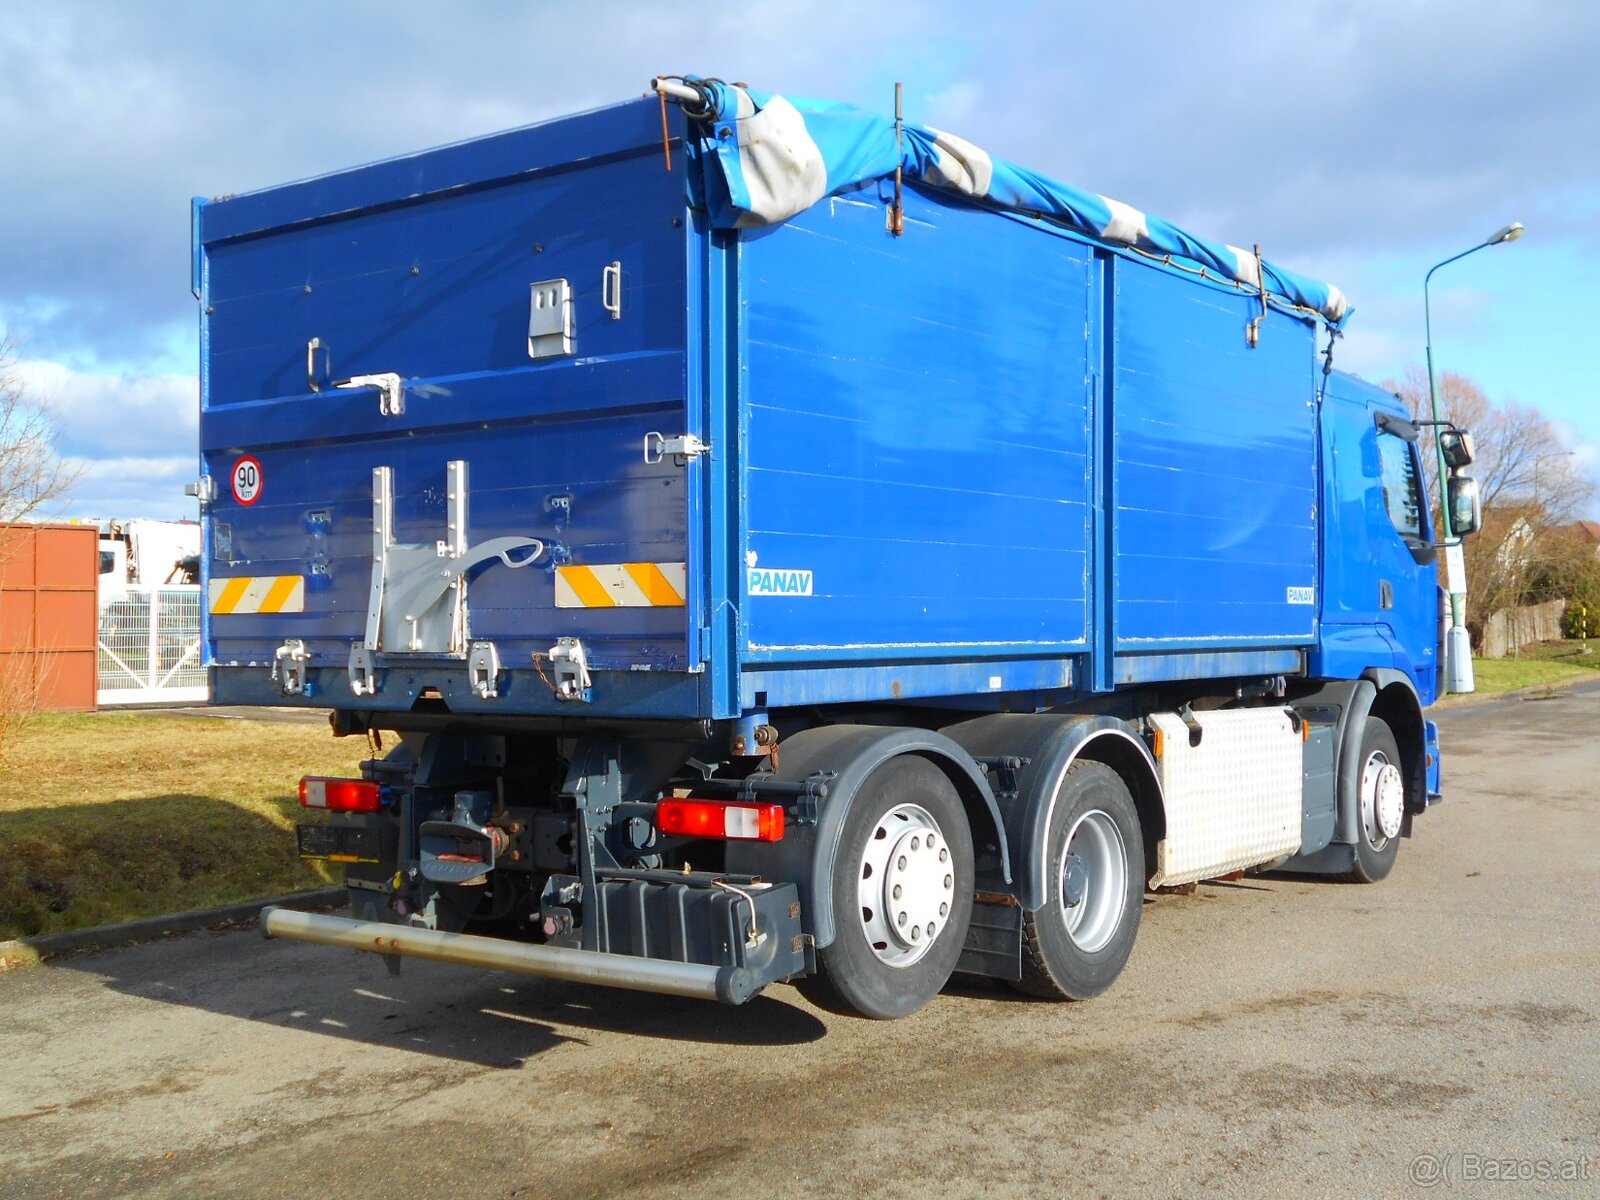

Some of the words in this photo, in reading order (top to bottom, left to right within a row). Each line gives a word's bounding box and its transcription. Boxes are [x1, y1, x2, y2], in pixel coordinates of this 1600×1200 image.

[238, 465, 255, 488] 90
[749, 571, 811, 593] PANAV
[1289, 589, 1313, 602] PANAV
